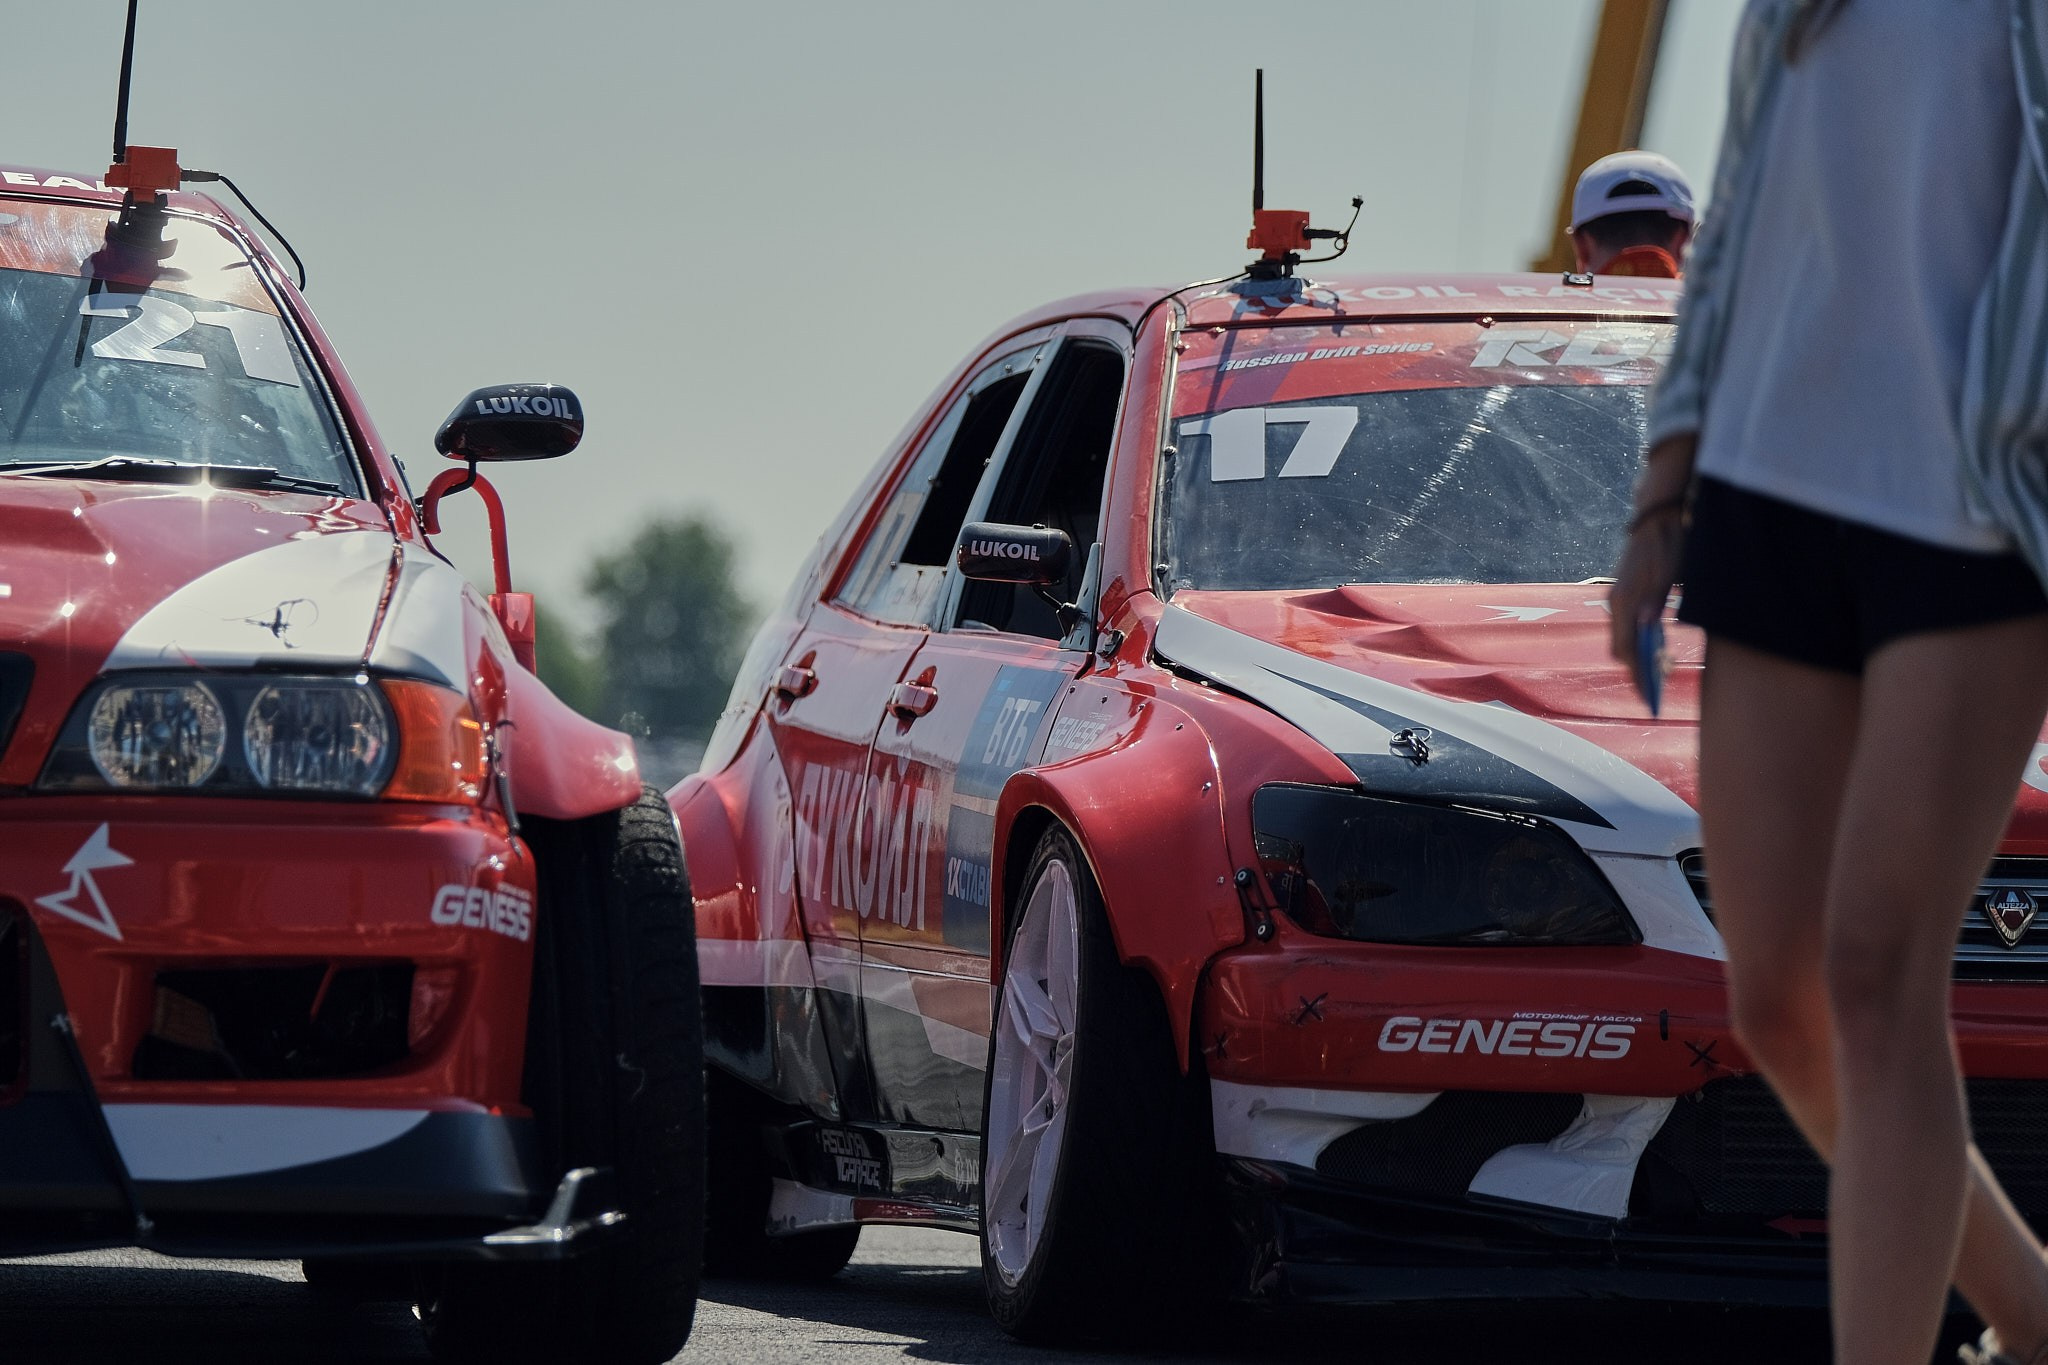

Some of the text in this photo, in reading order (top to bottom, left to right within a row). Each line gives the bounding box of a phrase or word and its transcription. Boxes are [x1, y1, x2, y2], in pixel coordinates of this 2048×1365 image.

[79, 293, 301, 387] 21
[1218, 342, 1434, 371] Russian Drift Series
[475, 396, 574, 420] LUKOIL
[1180, 406, 1359, 482] 17
[970, 540, 1041, 561] LUKOIL
[982, 697, 1042, 768] ВТБ
[1048, 716, 1107, 751] GENESIS
[431, 884, 531, 942] GENESIS
[1377, 1016, 1636, 1059] GENESIS
[1592, 1015, 1642, 1023] МАСЛА
